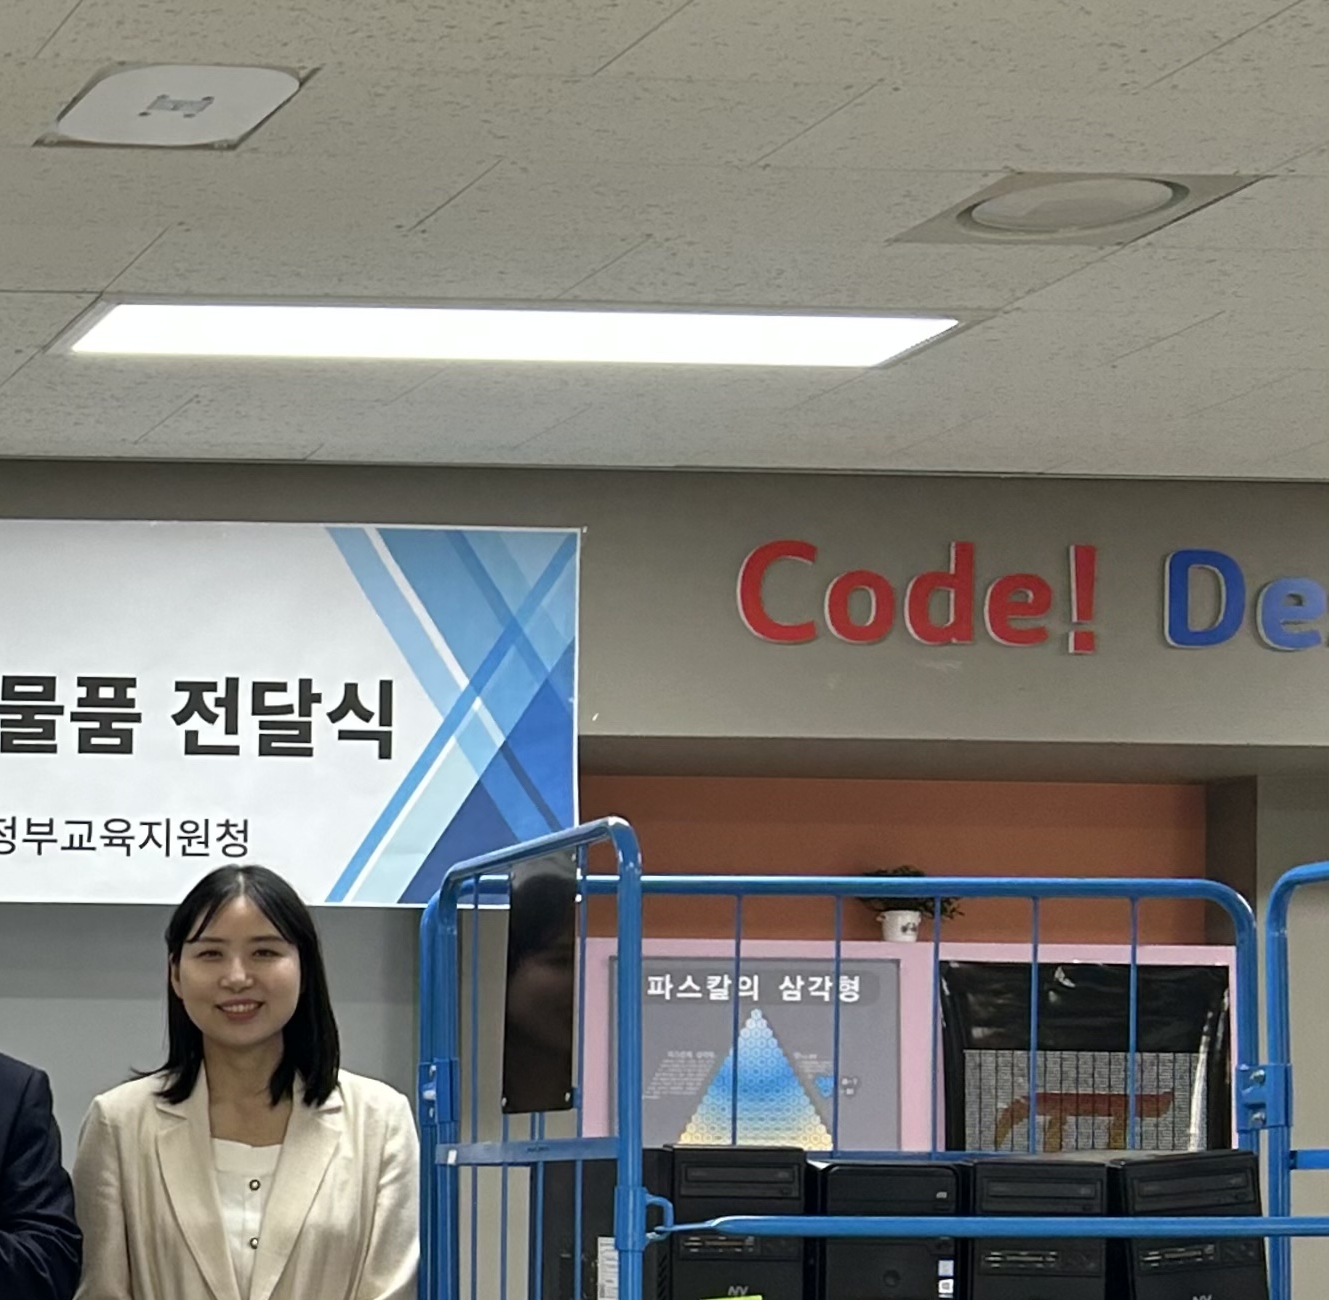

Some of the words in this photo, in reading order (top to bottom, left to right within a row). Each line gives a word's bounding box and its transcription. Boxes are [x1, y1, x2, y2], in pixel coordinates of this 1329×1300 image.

[736, 539, 1098, 655] Code!
[1163, 547, 1329, 651] De
[170, 676, 394, 761] 전달식
[647, 973, 759, 1002] 파스칼의
[778, 975, 860, 1003] 삼각형
